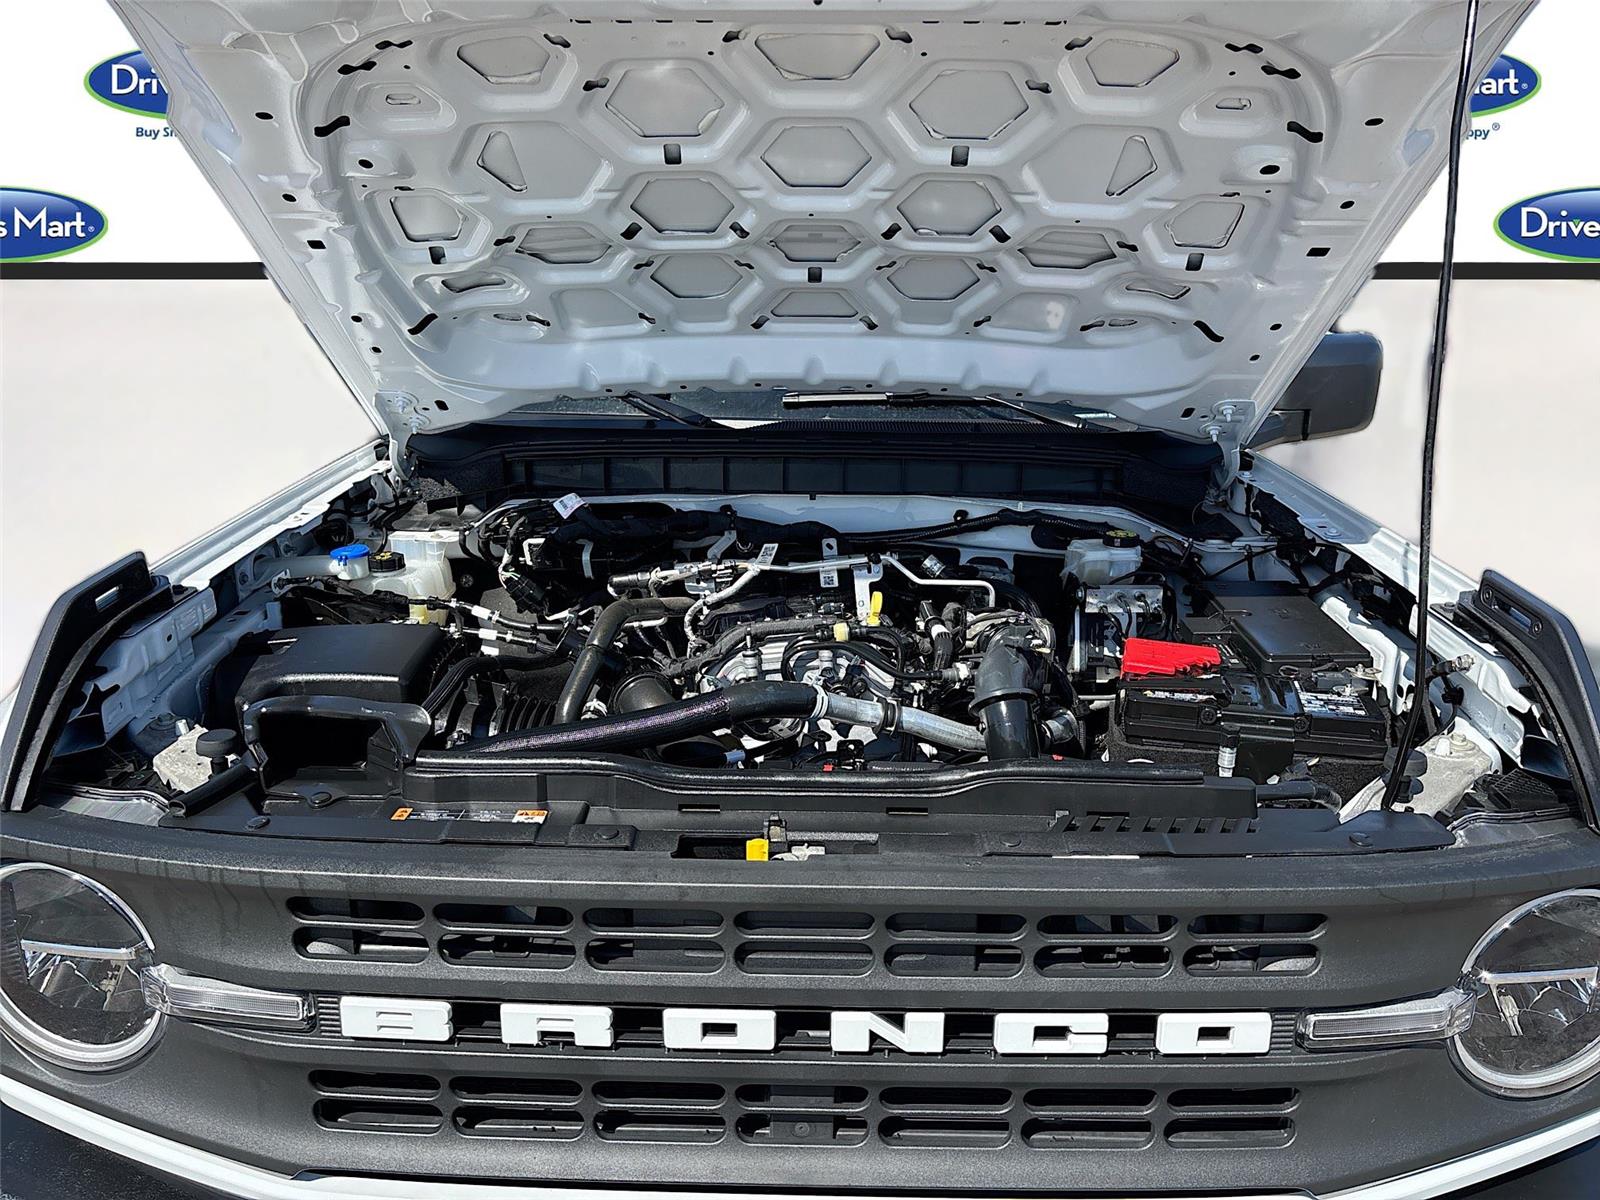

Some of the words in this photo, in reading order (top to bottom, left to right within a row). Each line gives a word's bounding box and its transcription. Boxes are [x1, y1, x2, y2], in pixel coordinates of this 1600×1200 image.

[1473, 69, 1520, 95] art
[136, 127, 160, 140] Buy
[14, 206, 86, 238] Mart
[340, 996, 1272, 1054] BRONCO
